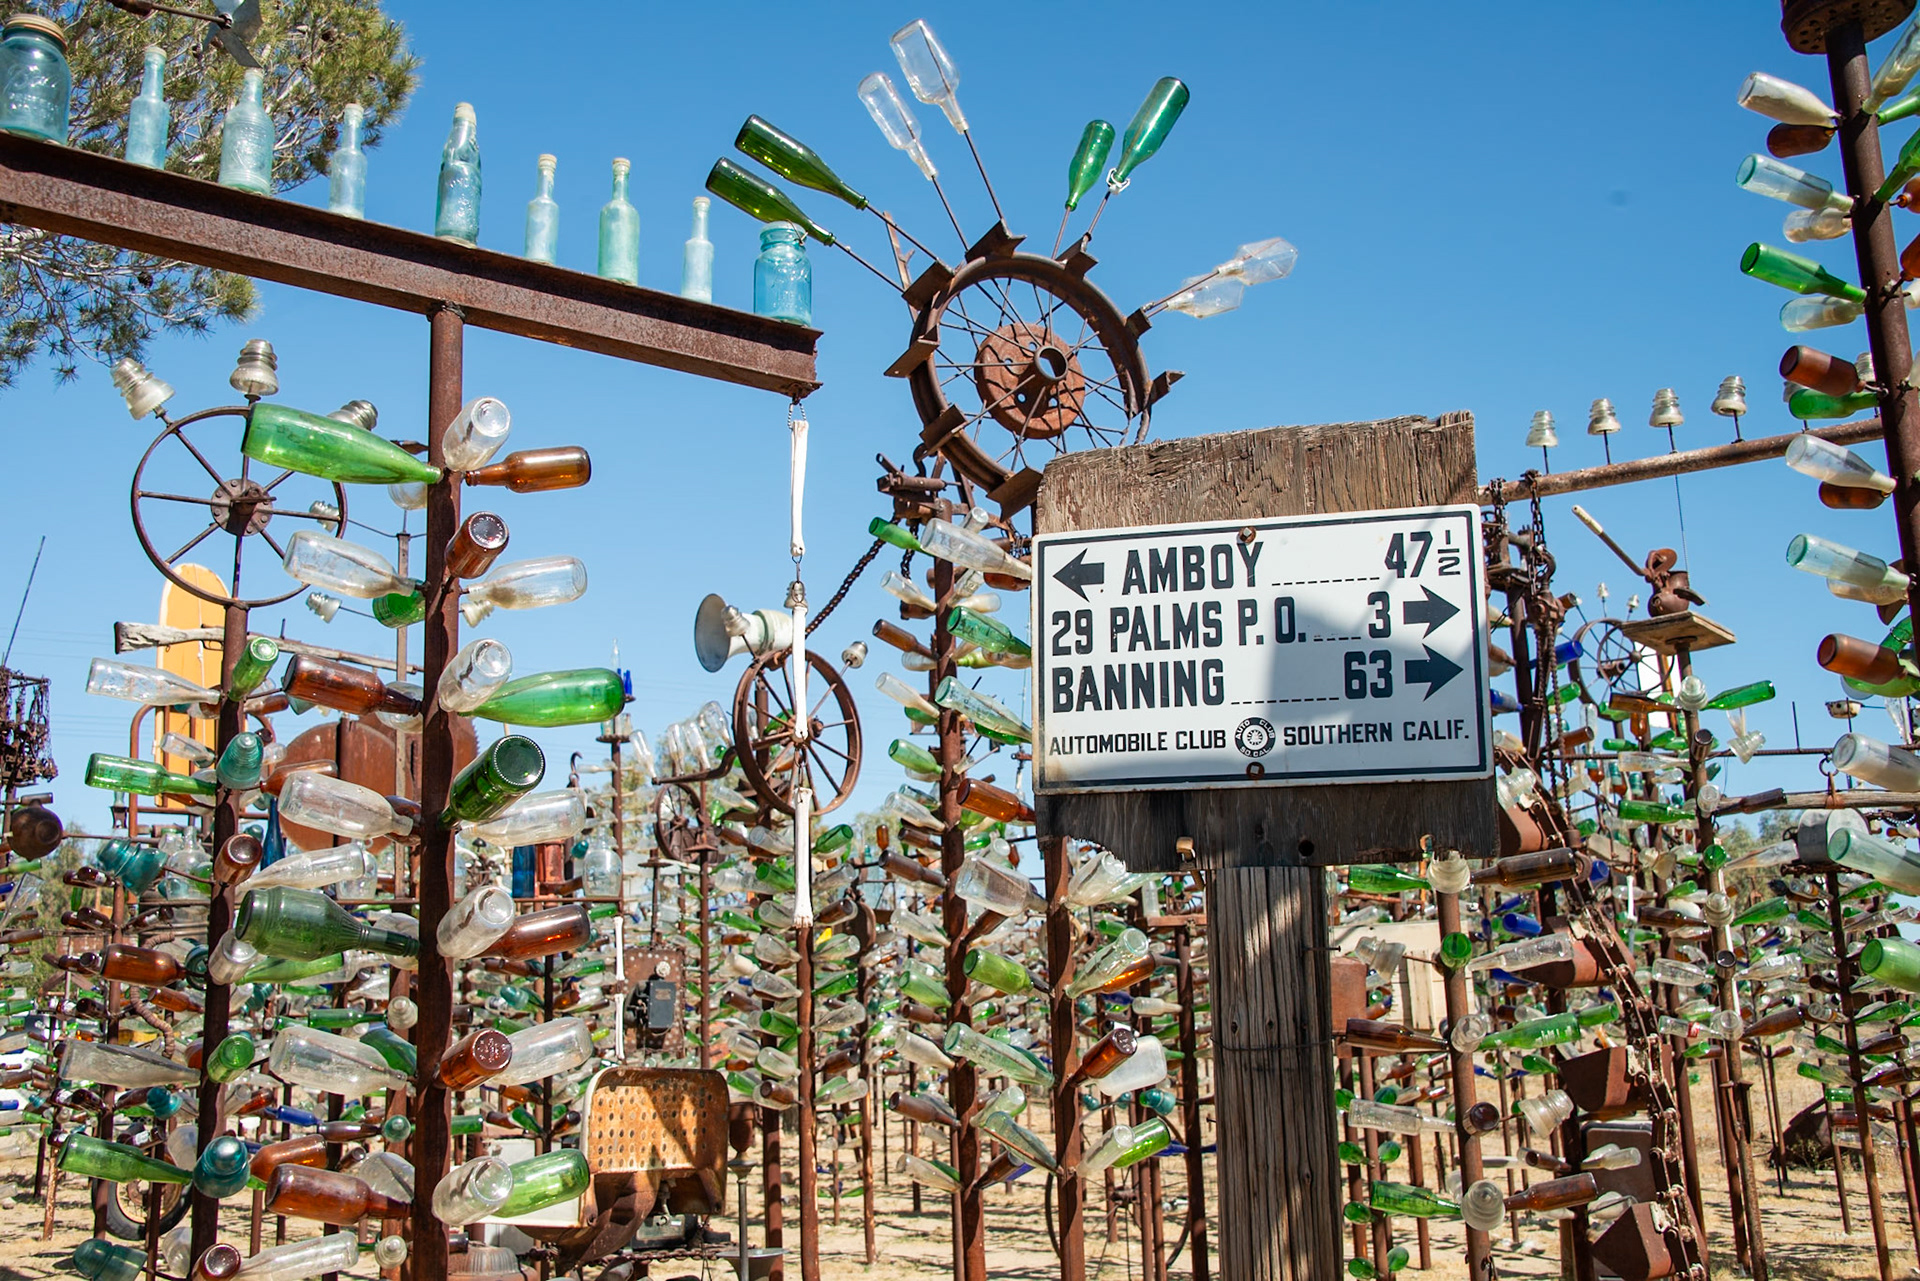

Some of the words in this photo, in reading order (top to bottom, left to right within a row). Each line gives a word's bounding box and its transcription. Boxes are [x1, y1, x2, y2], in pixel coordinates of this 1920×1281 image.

[1121, 541, 1265, 595] AMBOY
[1385, 531, 1433, 578] 47
[1052, 609, 1093, 656] 29
[1110, 601, 1222, 652] PALMS
[1368, 591, 1391, 639] 3
[1052, 659, 1224, 713] BANNING
[1344, 650, 1393, 699] 63
[1050, 732, 1168, 755] AUTOMOBILE
[1176, 730, 1226, 750] CLUB
[1284, 722, 1392, 746] SOUTHERN
[1403, 720, 1469, 741] CALIF.
[1235, 719, 1250, 740] AUTO
[1259, 719, 1275, 739] CLUB
